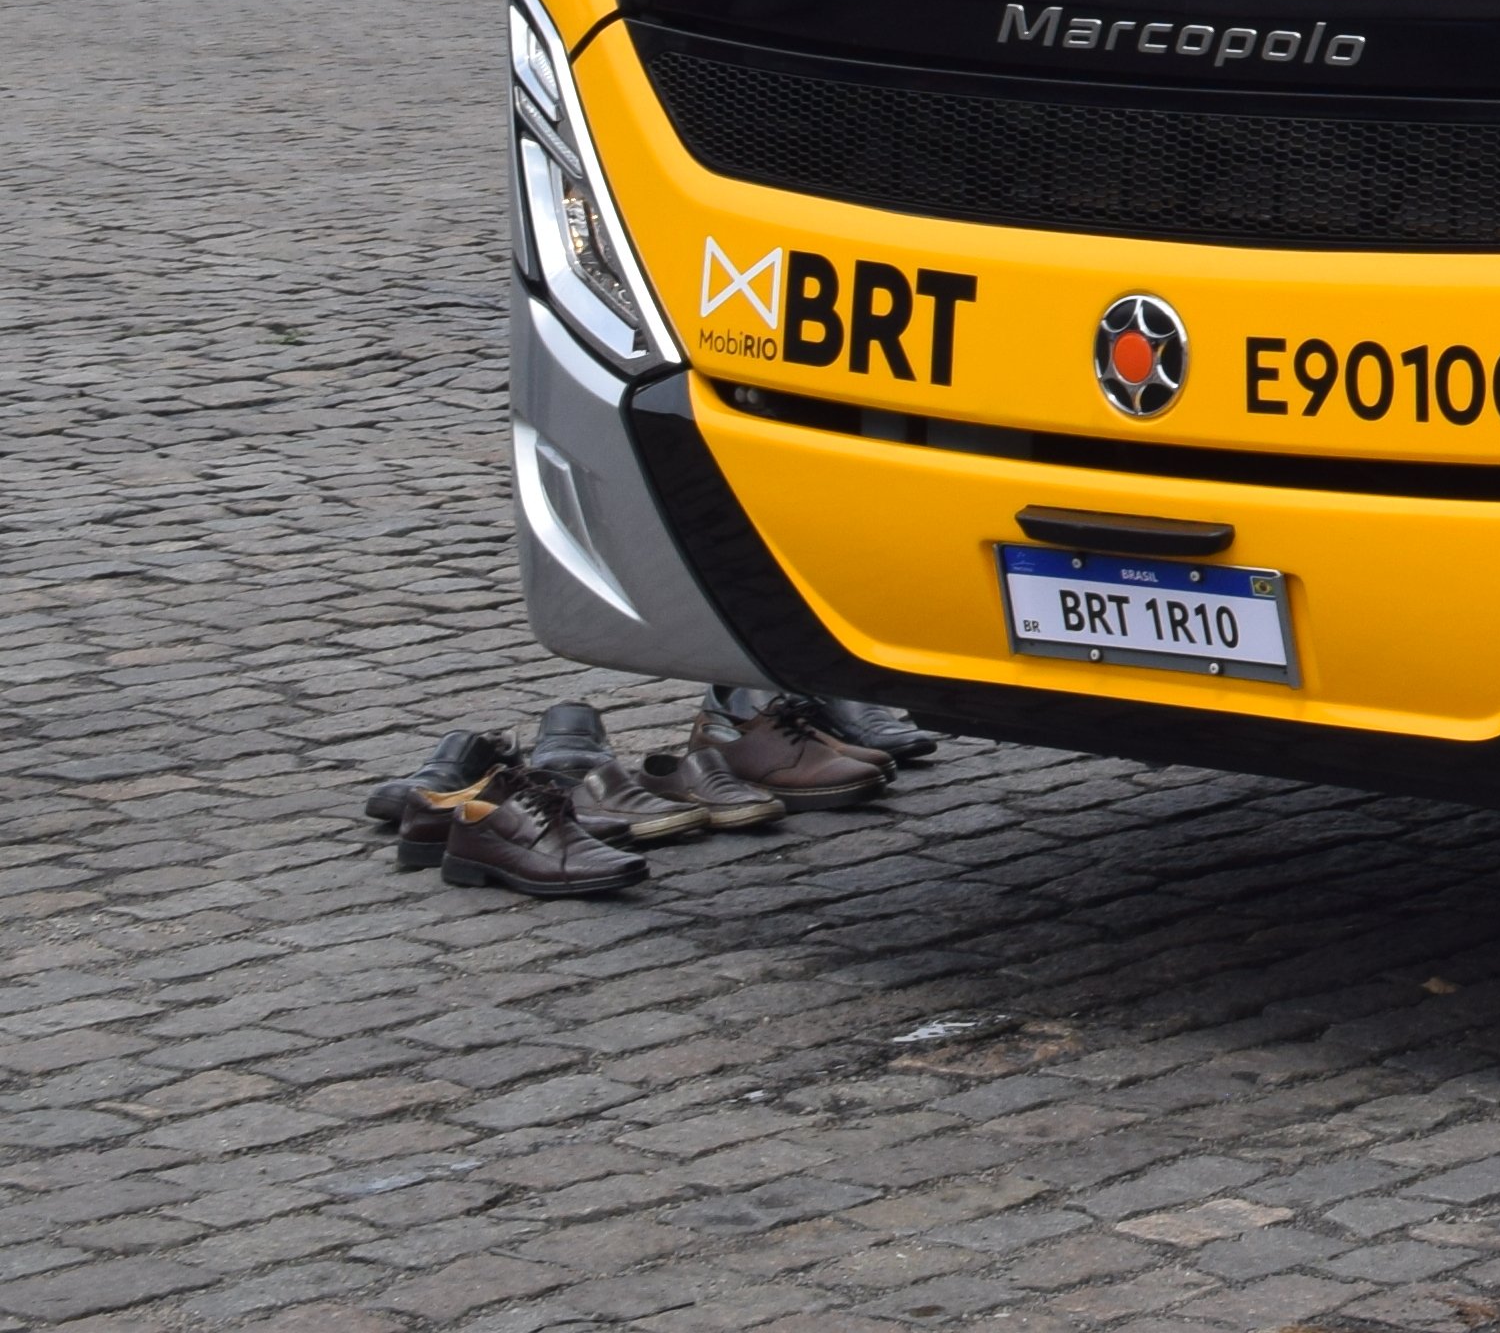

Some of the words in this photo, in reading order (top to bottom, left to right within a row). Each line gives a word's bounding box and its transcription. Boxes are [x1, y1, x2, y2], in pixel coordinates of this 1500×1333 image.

[997, 2, 1367, 68] Marcopolo
[782, 250, 979, 387] BRT
[699, 327, 778, 362] MobiRIO
[1120, 567, 1160, 583] BRASIL
[1022, 618, 1040, 634] BR
[1058, 588, 1131, 638] BRT
[1144, 597, 1240, 650] 1R10
